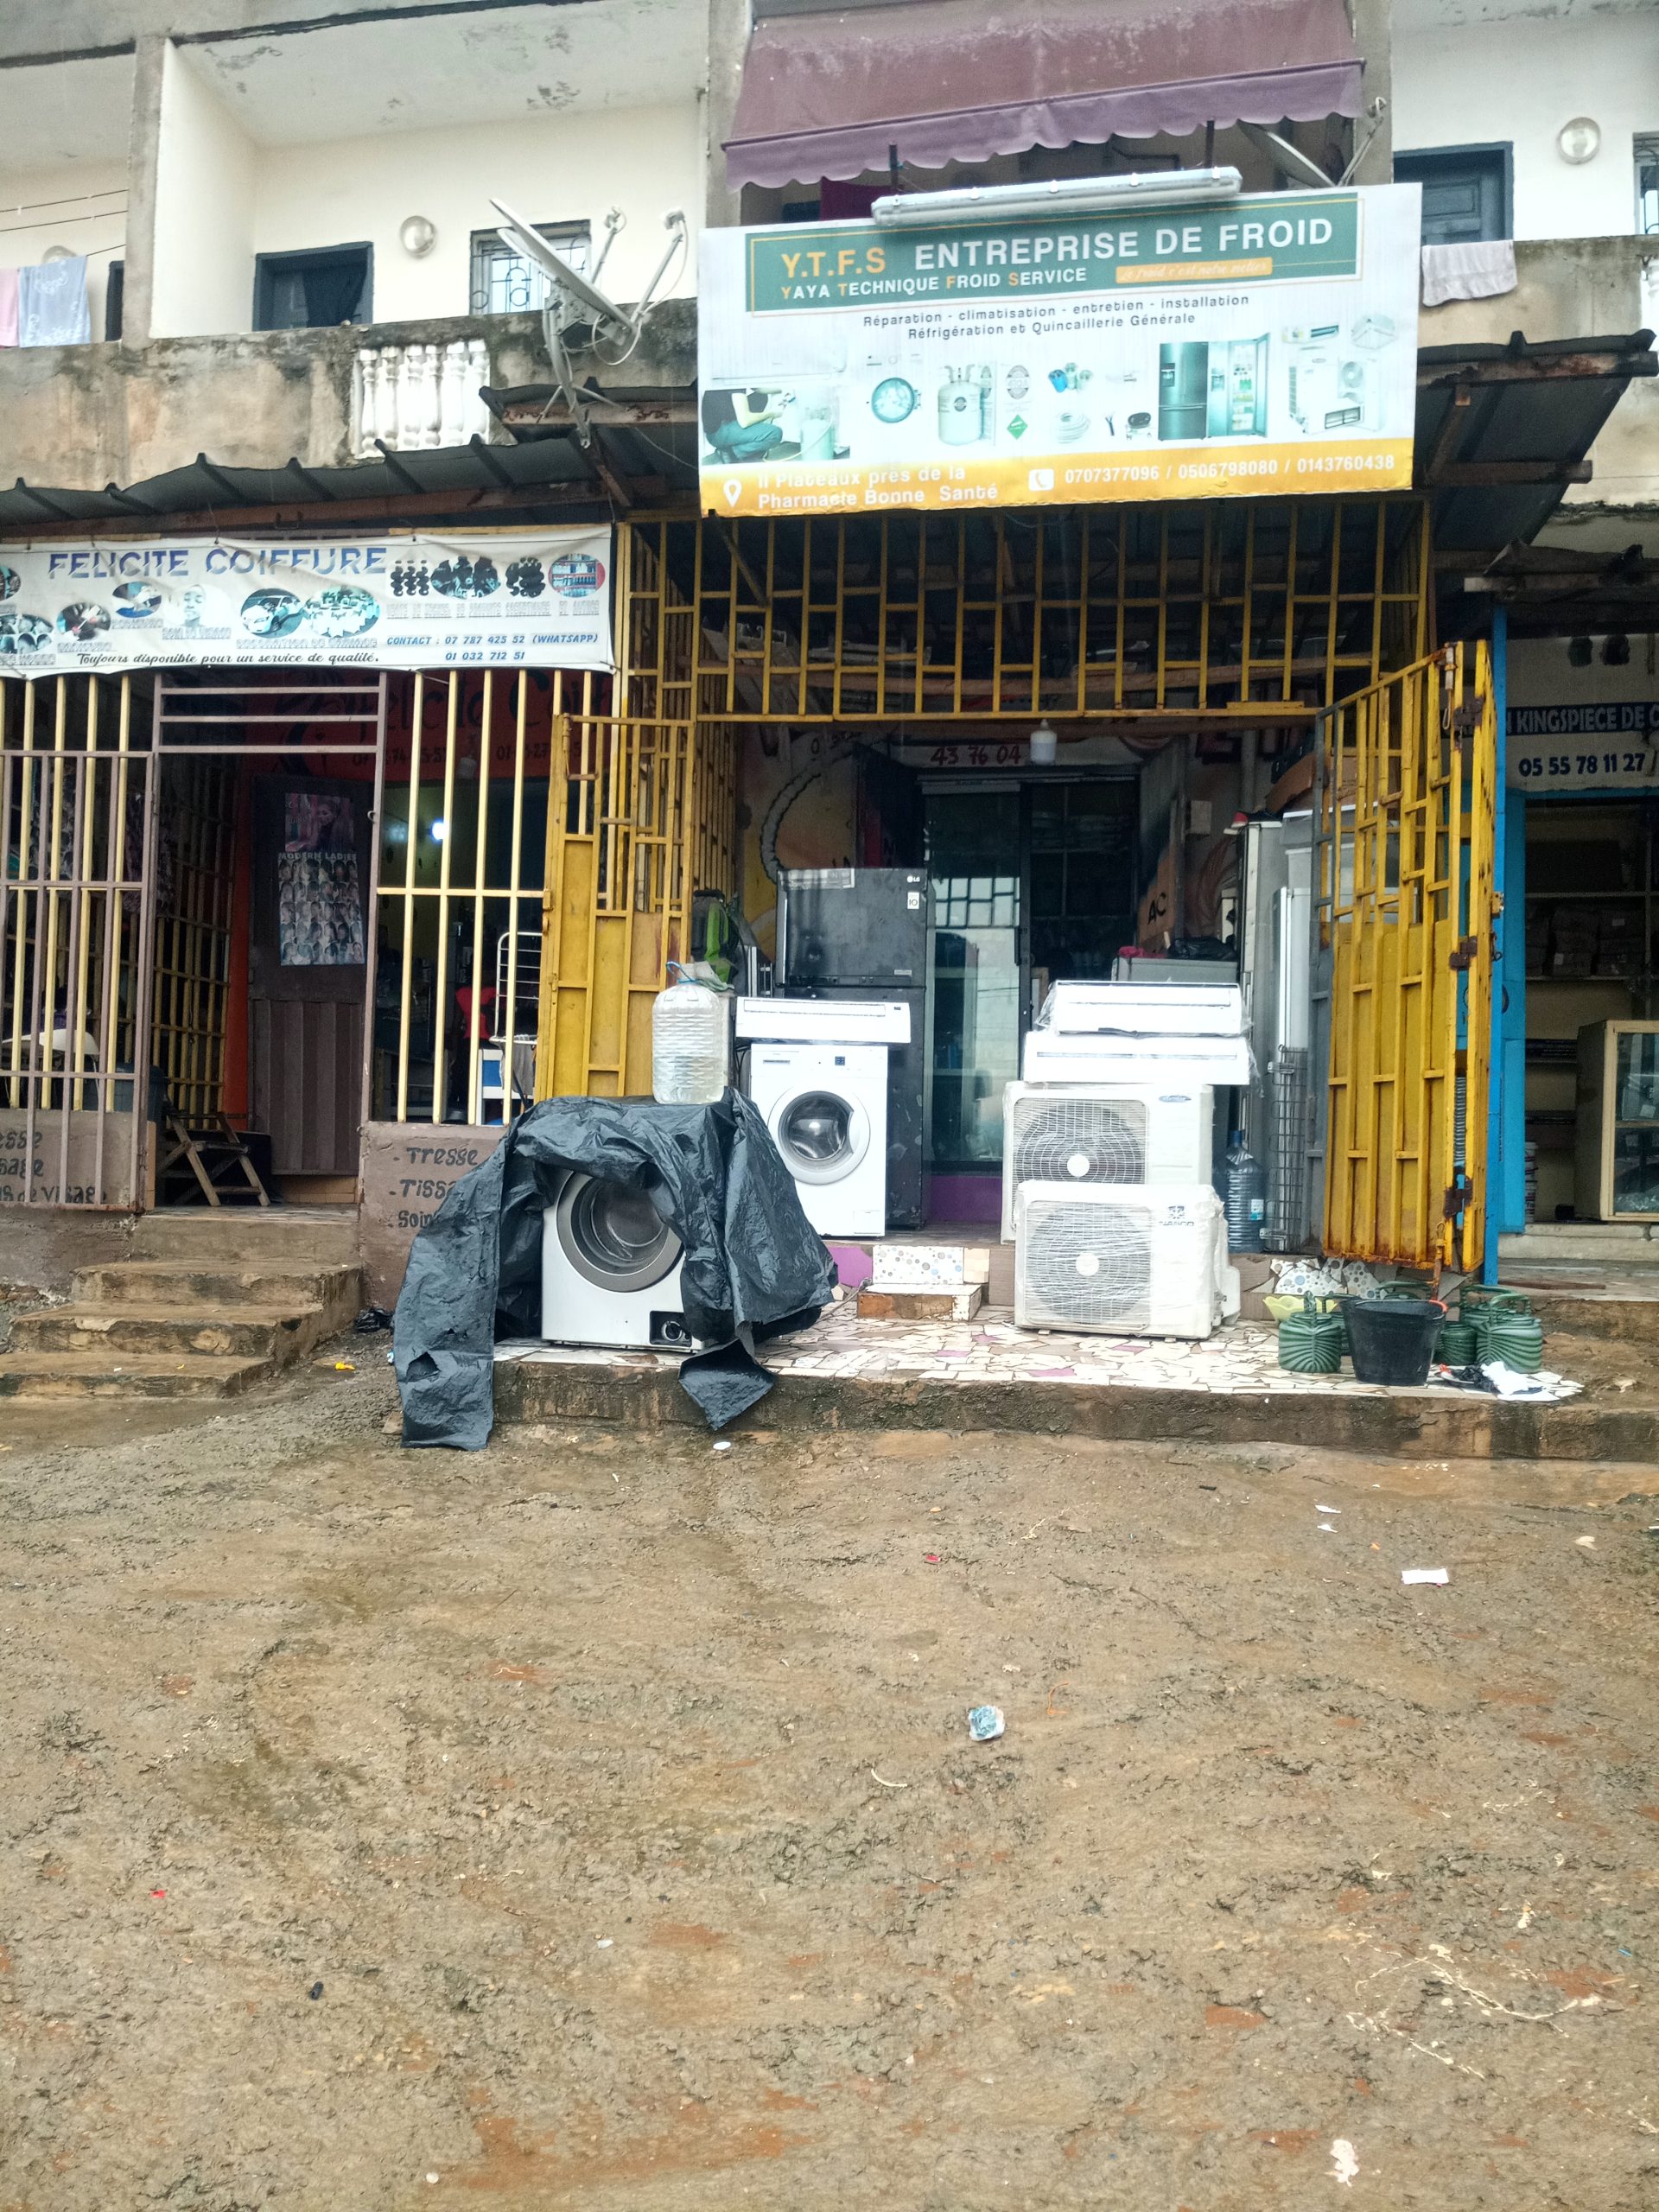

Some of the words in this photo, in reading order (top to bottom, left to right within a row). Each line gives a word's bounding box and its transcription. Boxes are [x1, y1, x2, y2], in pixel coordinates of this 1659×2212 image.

[780, 247, 887, 278] Y.T.F.S
[914, 231, 1139, 270] ENTREPRISE
[1155, 226, 1203, 255] DE
[1218, 218, 1333, 251] FROID
[781, 284, 831, 300] YAYA
[838, 276, 939, 297] TECHNIQUE
[946, 272, 1001, 289] FROID
[1008, 267, 1087, 286] SERVICE
[863, 312, 942, 328] Réparation
[958, 307, 1056, 321] climatisation
[1073, 301, 1144, 315] entretien
[1161, 295, 1249, 308] installation
[908, 324, 1004, 340] Réfrigération
[1010, 323, 1026, 334] et
[1032, 316, 1123, 335] Quincaillerie
[1130, 313, 1195, 326] Générale
[777, 471, 861, 488] Plateaux
[868, 469, 911, 489] près
[918, 466, 941, 481] de
[949, 465, 965, 480] la
[1065, 465, 1160, 484] 0707377096
[1166, 464, 1173, 480] /
[1179, 461, 1278, 479] 0506798080
[1284, 459, 1290, 474] /
[1297, 454, 1395, 474] 0143760438
[865, 488, 925, 505] Bonne
[939, 483, 998, 501] Santé
[48, 550, 189, 580] FELICITE
[206, 548, 387, 575] COIFFURE
[386, 636, 432, 645] CONTACT
[445, 636, 458, 645] 07
[463, 636, 482, 645] 787
[487, 635, 507, 644] 425
[512, 635, 525, 644] 52
[532, 634, 598, 644] (WHATSAPP)
[77, 652, 128, 667] Toujours
[133, 652, 197, 666] disponible
[201, 655, 232, 666] pour
[236, 654, 253, 663] un
[257, 653, 302, 664] service
[308, 652, 324, 663] de
[445, 652, 457, 660] 01
[462, 652, 483, 660] 032
[490, 652, 507, 660] 712
[513, 652, 525, 660] 51
[1622, 705, 1645, 728] DE
[930, 746, 959, 765] 43
[968, 745, 988, 763] 76
[996, 745, 1021, 764] 04
[1518, 758, 1543, 777] 05
[1548, 756, 1571, 775] 55
[1576, 755, 1598, 774] 78
[1603, 753, 1618, 772] 11
[1623, 753, 1645, 772] 27
[406, 1147, 479, 1166] Tresse
